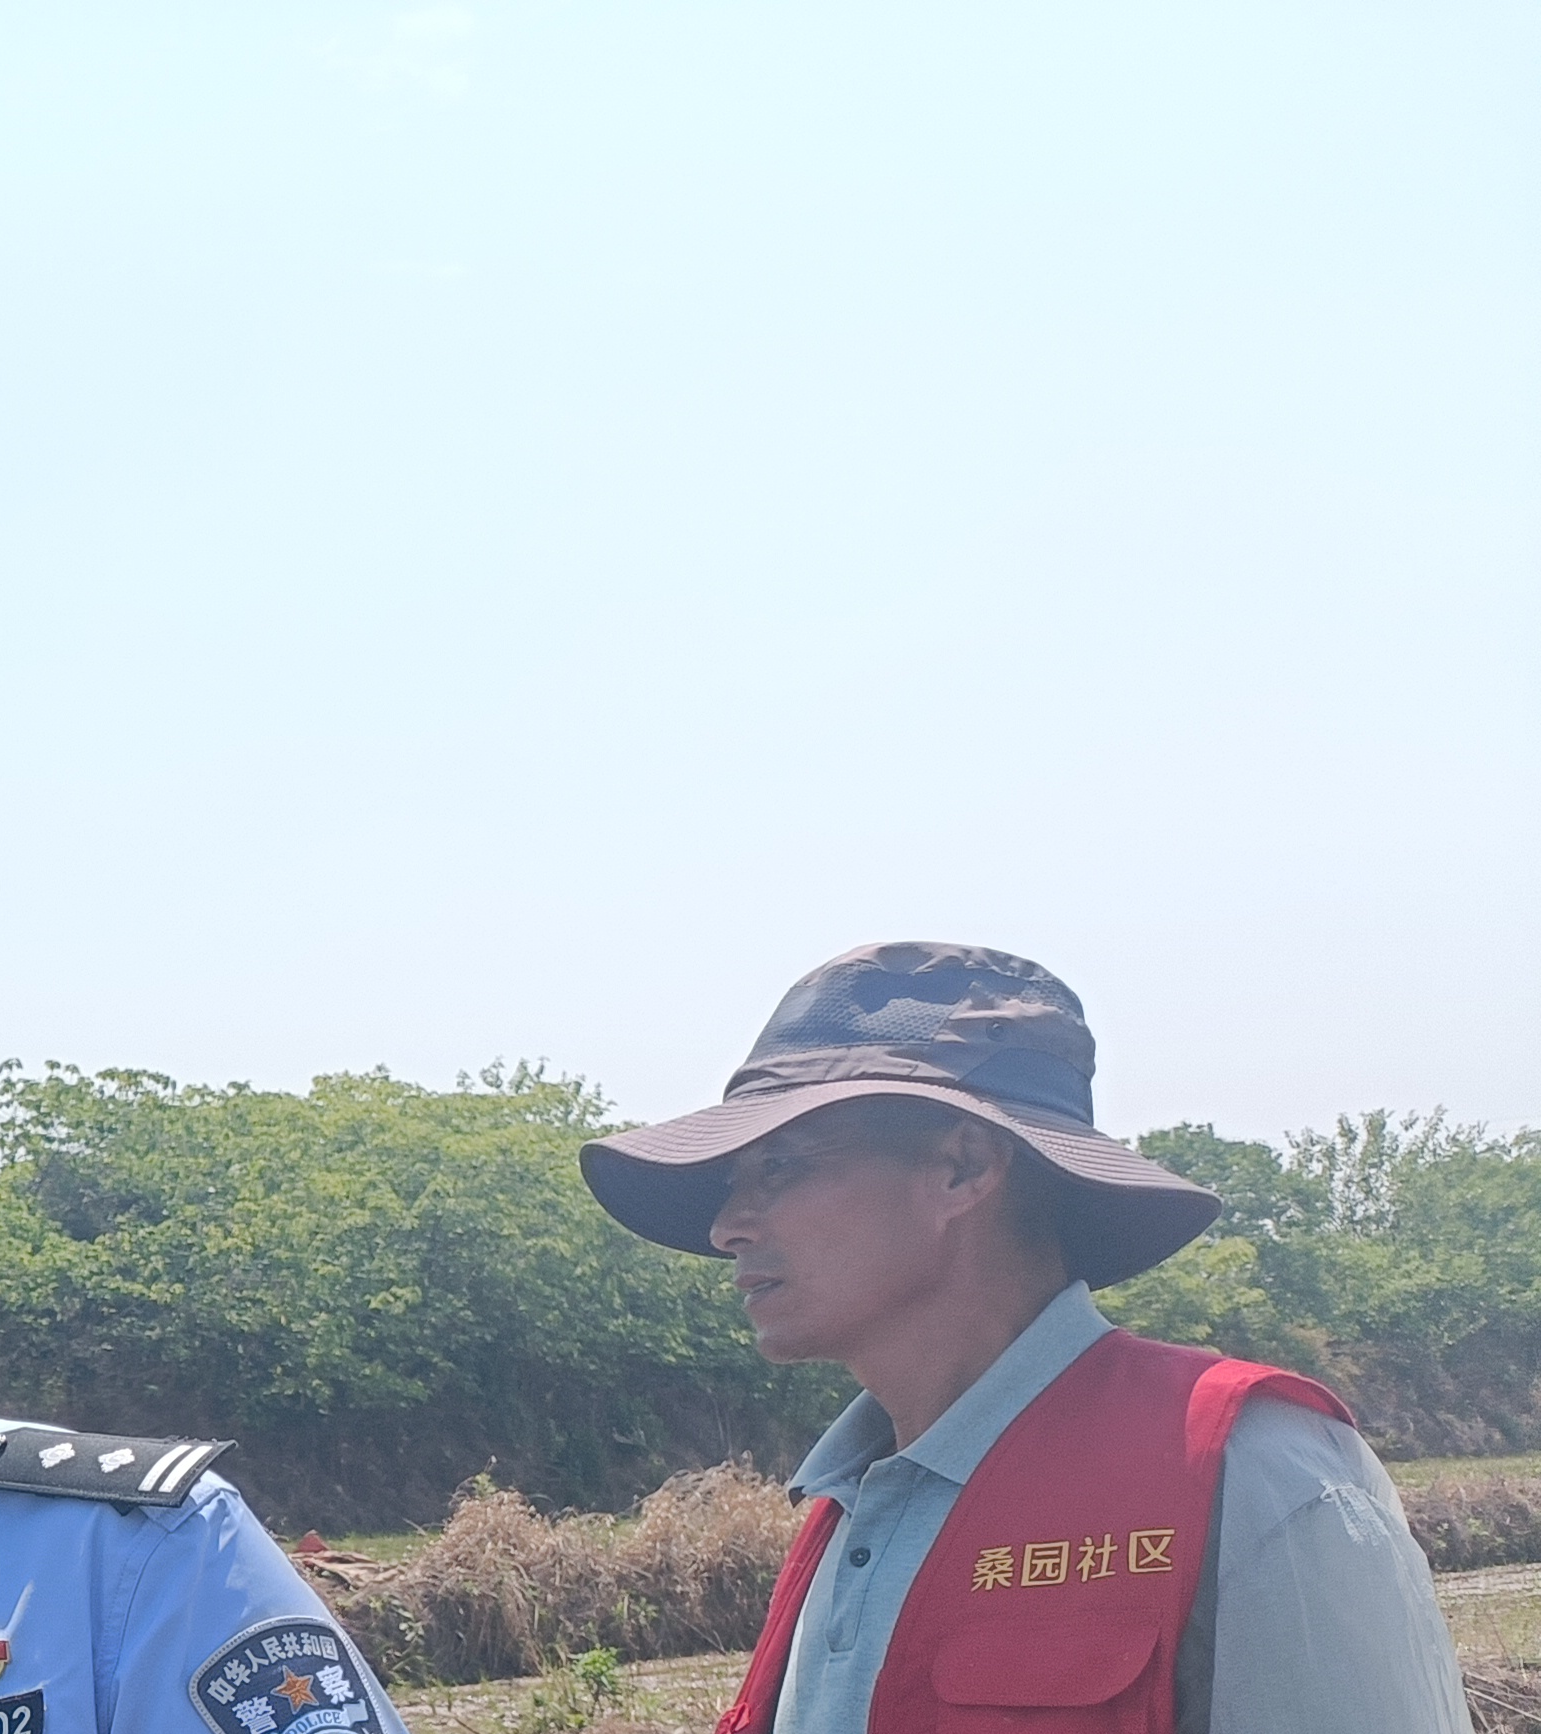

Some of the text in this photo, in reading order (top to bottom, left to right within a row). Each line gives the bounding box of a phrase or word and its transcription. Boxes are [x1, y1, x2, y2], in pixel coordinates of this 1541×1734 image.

[970, 1529, 1176, 1592] 桑园社区
[207, 1632, 339, 1705] 中华人民共和国
